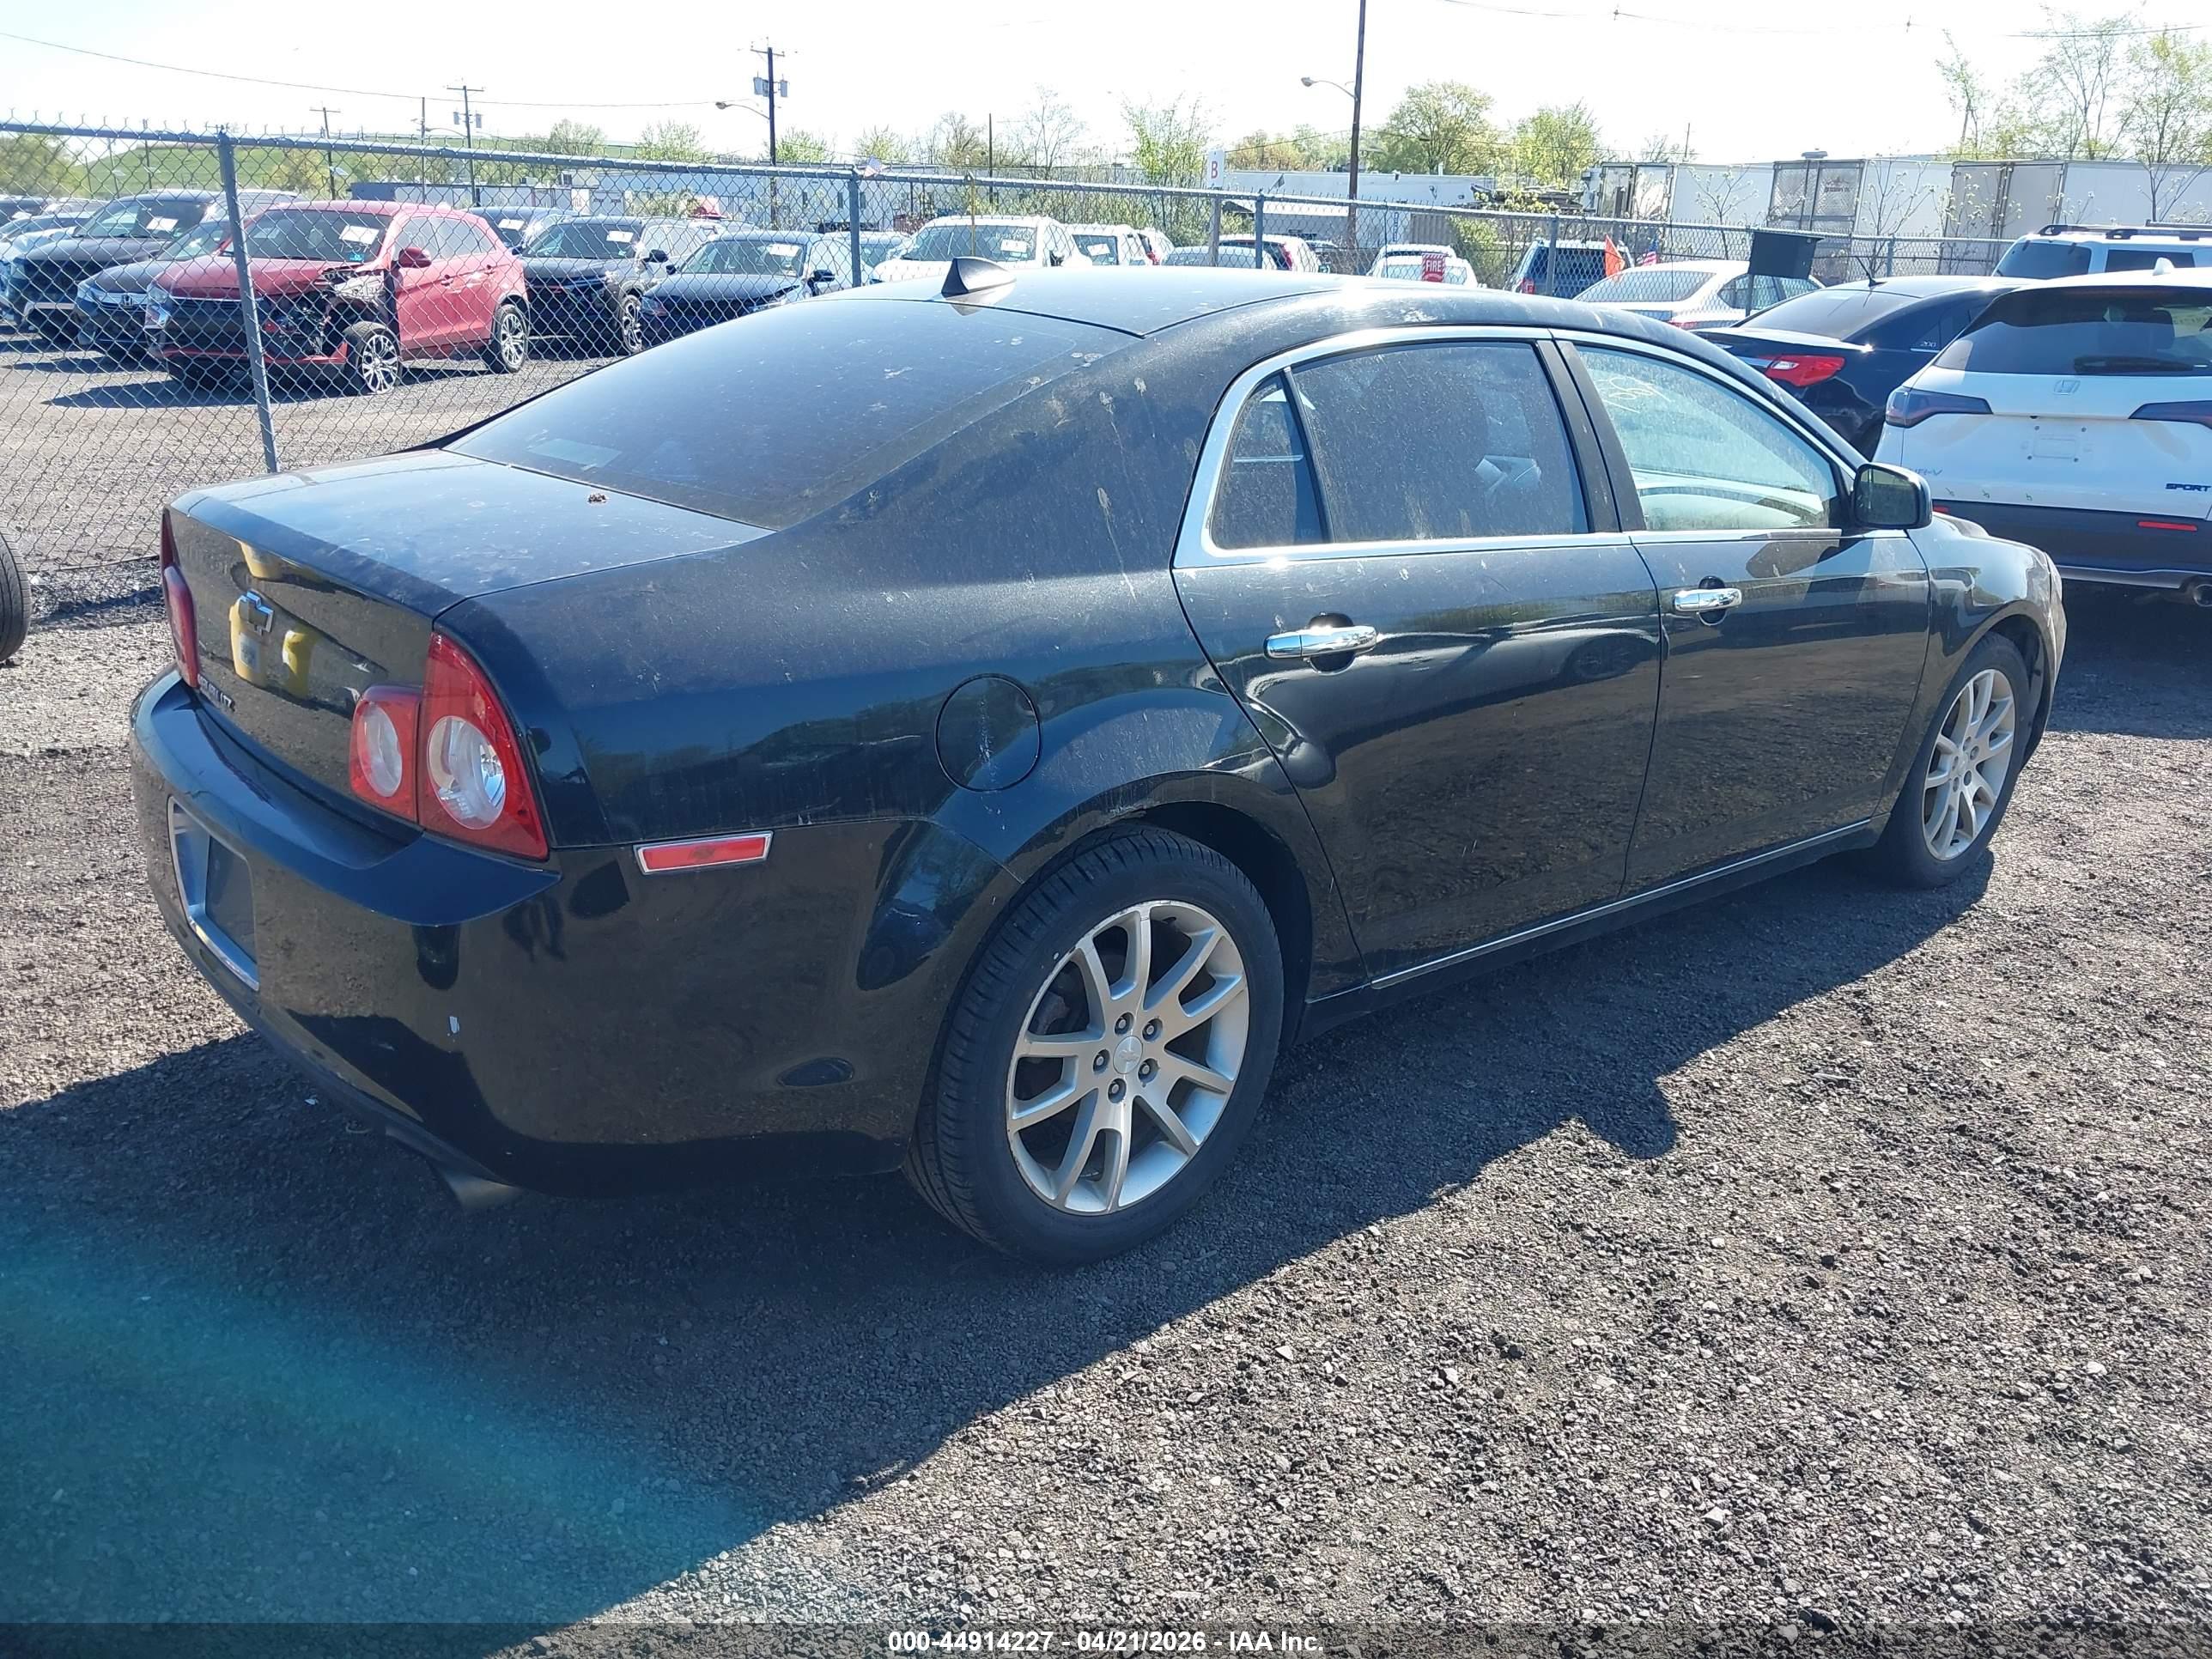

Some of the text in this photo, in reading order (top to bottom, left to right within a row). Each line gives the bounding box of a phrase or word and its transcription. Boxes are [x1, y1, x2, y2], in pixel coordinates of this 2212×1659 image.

[1212, 161, 1218, 179] B
[1425, 259, 1443, 272] FIRE
[2165, 483, 2212, 492] SPORT
